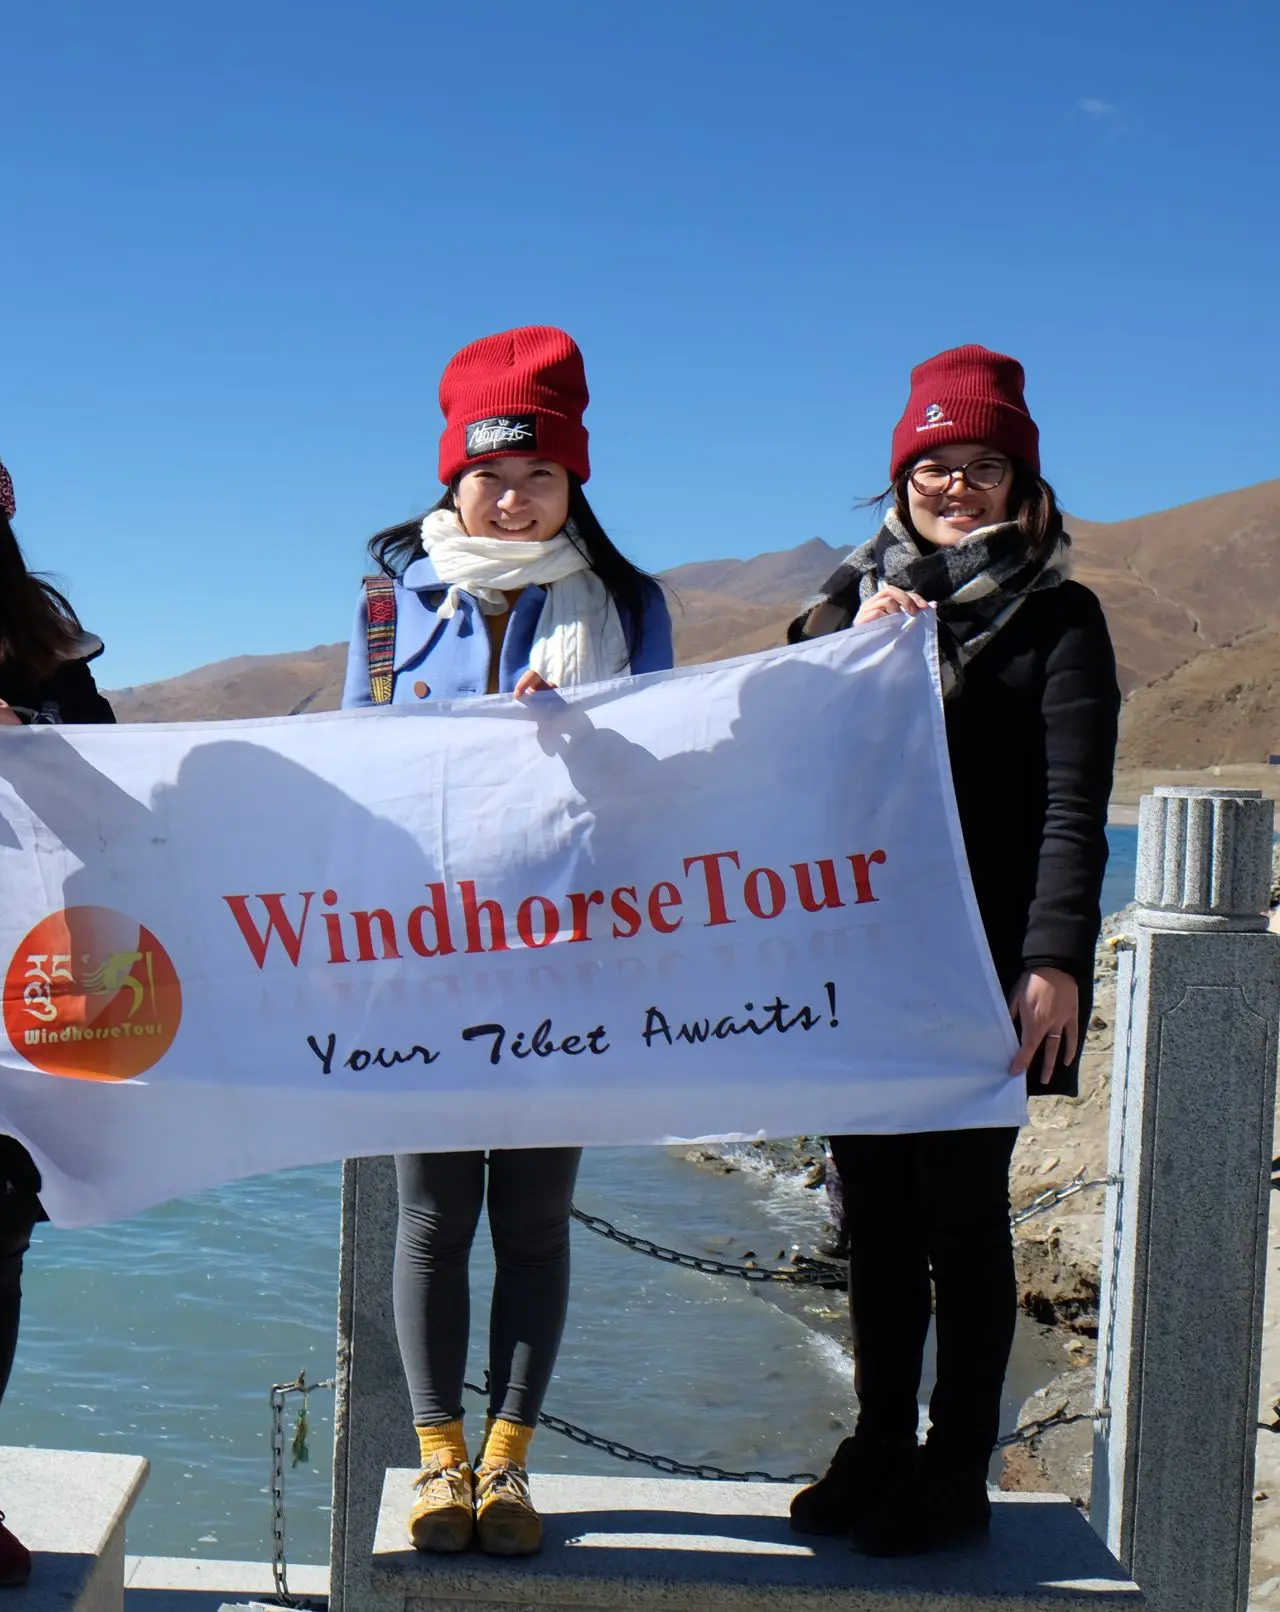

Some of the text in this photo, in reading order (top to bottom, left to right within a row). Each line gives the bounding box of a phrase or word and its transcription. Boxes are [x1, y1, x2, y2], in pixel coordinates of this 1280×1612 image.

[222, 848, 887, 970] WindhorseTour
[24, 1022, 162, 1045] WindhorseTour
[307, 981, 839, 1074] Your Tibet Awaits!
